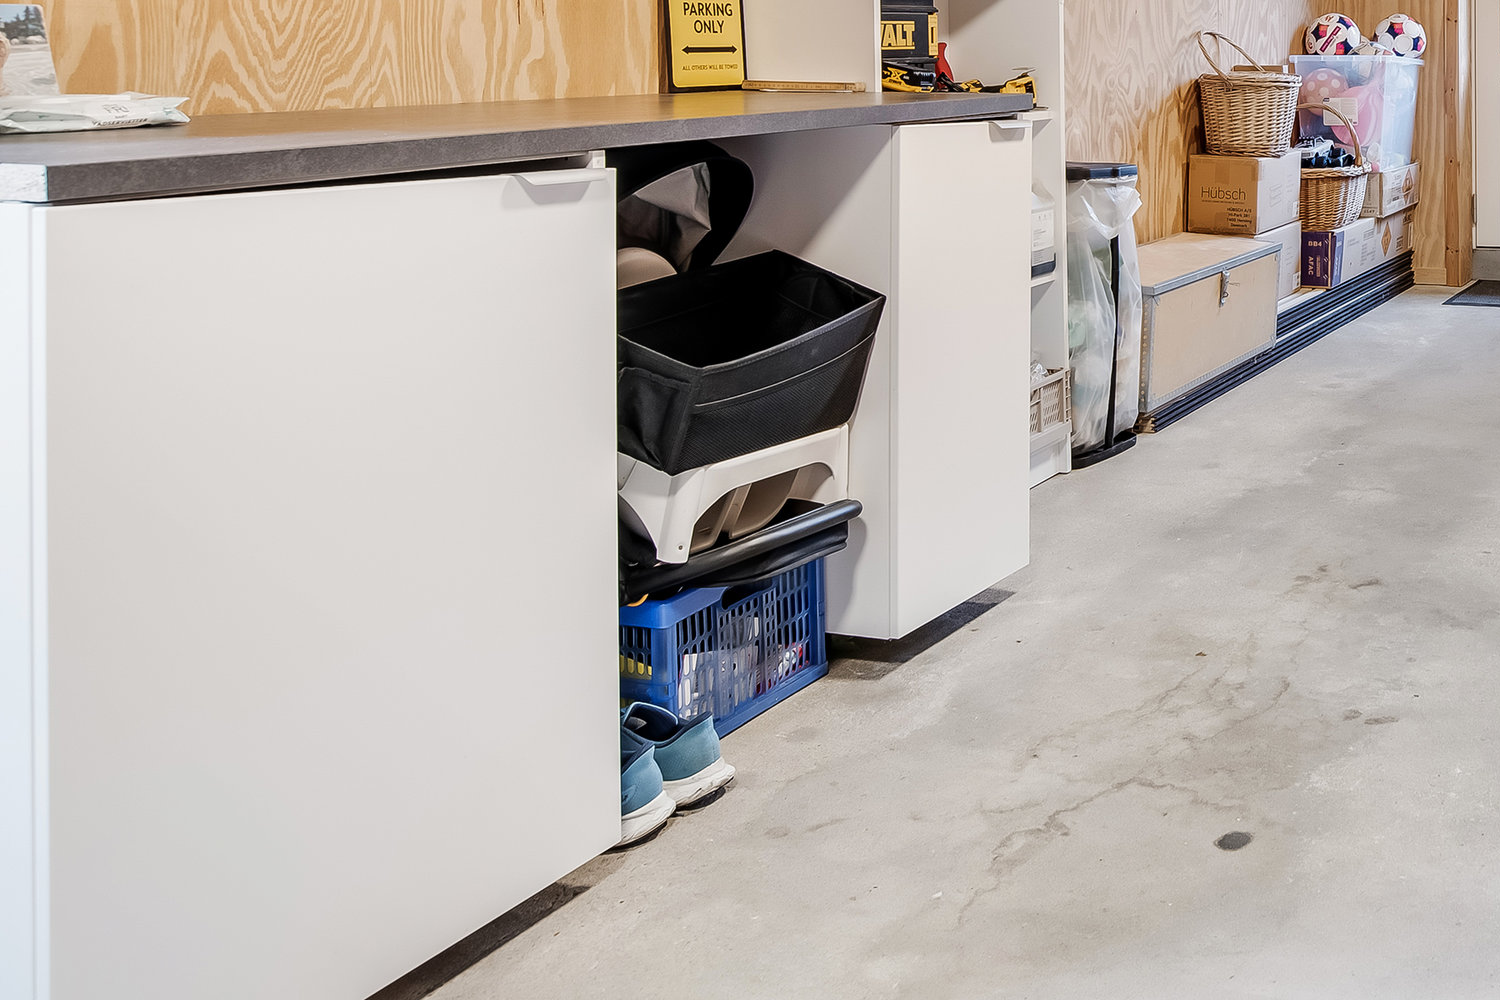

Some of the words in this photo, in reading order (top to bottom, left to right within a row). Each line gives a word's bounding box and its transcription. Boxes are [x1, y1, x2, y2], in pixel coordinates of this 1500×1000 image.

[682, 2, 733, 16] PARKING
[693, 19, 725, 34] ONLY
[1200, 186, 1246, 201] Hübsch
